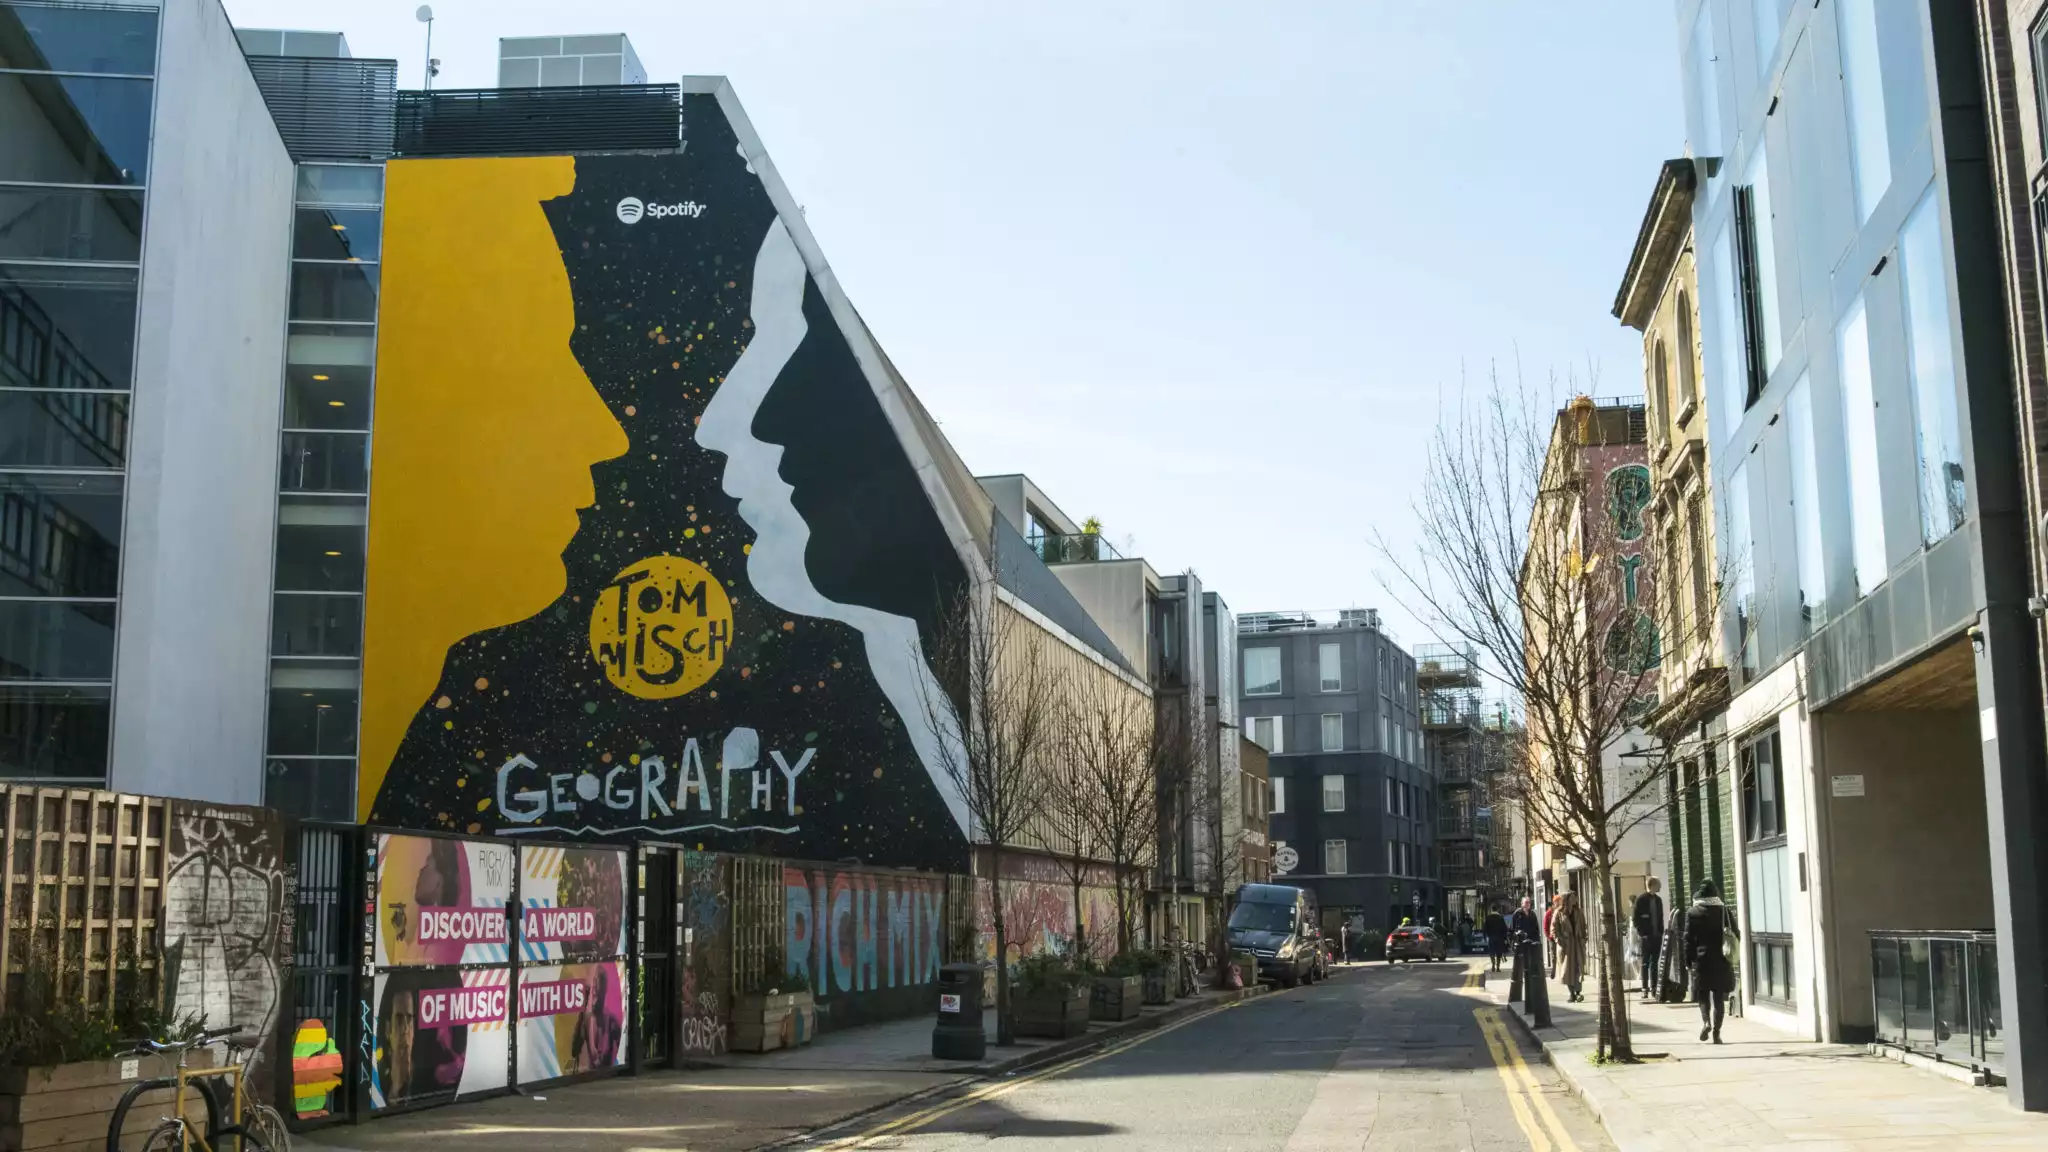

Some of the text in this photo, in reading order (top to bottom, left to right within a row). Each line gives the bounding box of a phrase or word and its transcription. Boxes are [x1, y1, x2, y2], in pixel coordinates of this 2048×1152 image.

[647, 201, 704, 219] Spotify
[613, 569, 708, 636] TOM
[600, 619, 728, 685] MISCH
[496, 726, 817, 823] GEOGRAPHY
[420, 911, 595, 939] DISCOVER A WORLD
[784, 868, 944, 995] RICH MIX
[421, 983, 585, 1024] OF MUSIC WITH US
